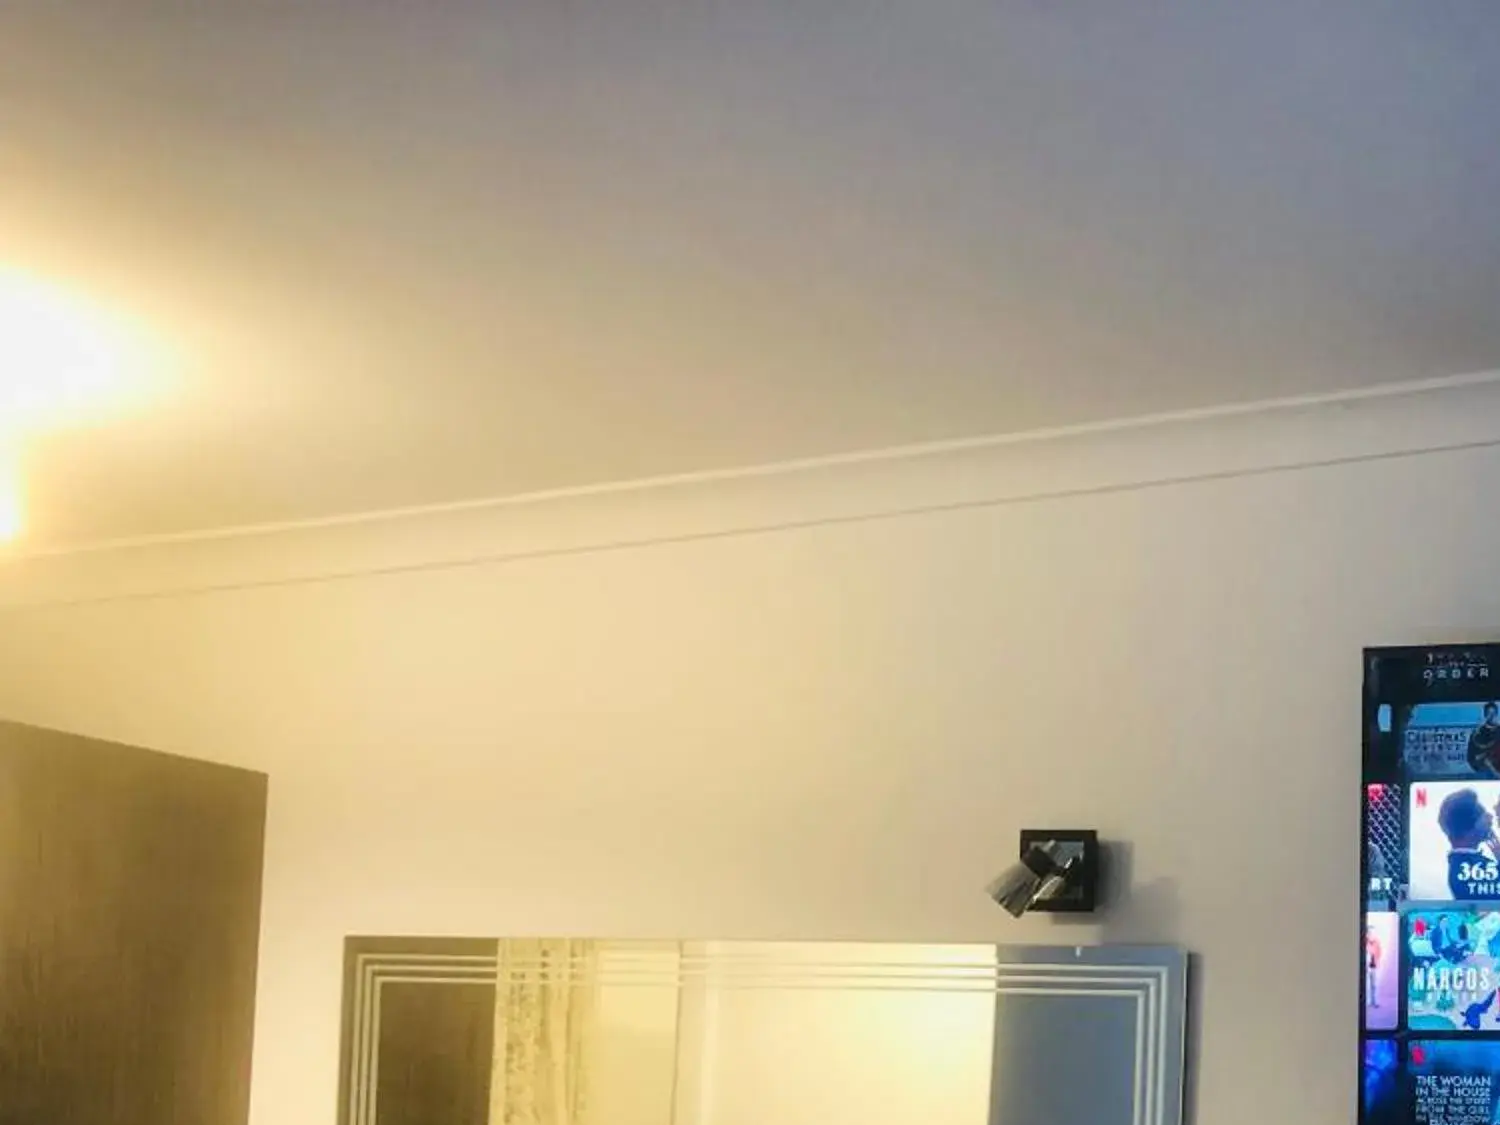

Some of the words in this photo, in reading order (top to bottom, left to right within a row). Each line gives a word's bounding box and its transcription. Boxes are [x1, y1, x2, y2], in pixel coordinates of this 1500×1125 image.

[1457, 862, 1499, 882] 365
[1413, 967, 1490, 991] NARCOS
[1416, 1075, 1438, 1087] THE
[1440, 1075, 1491, 1087] WOMAN
[1415, 1087, 1429, 1097] IN
[1453, 1087, 1491, 1097] HOUSE
